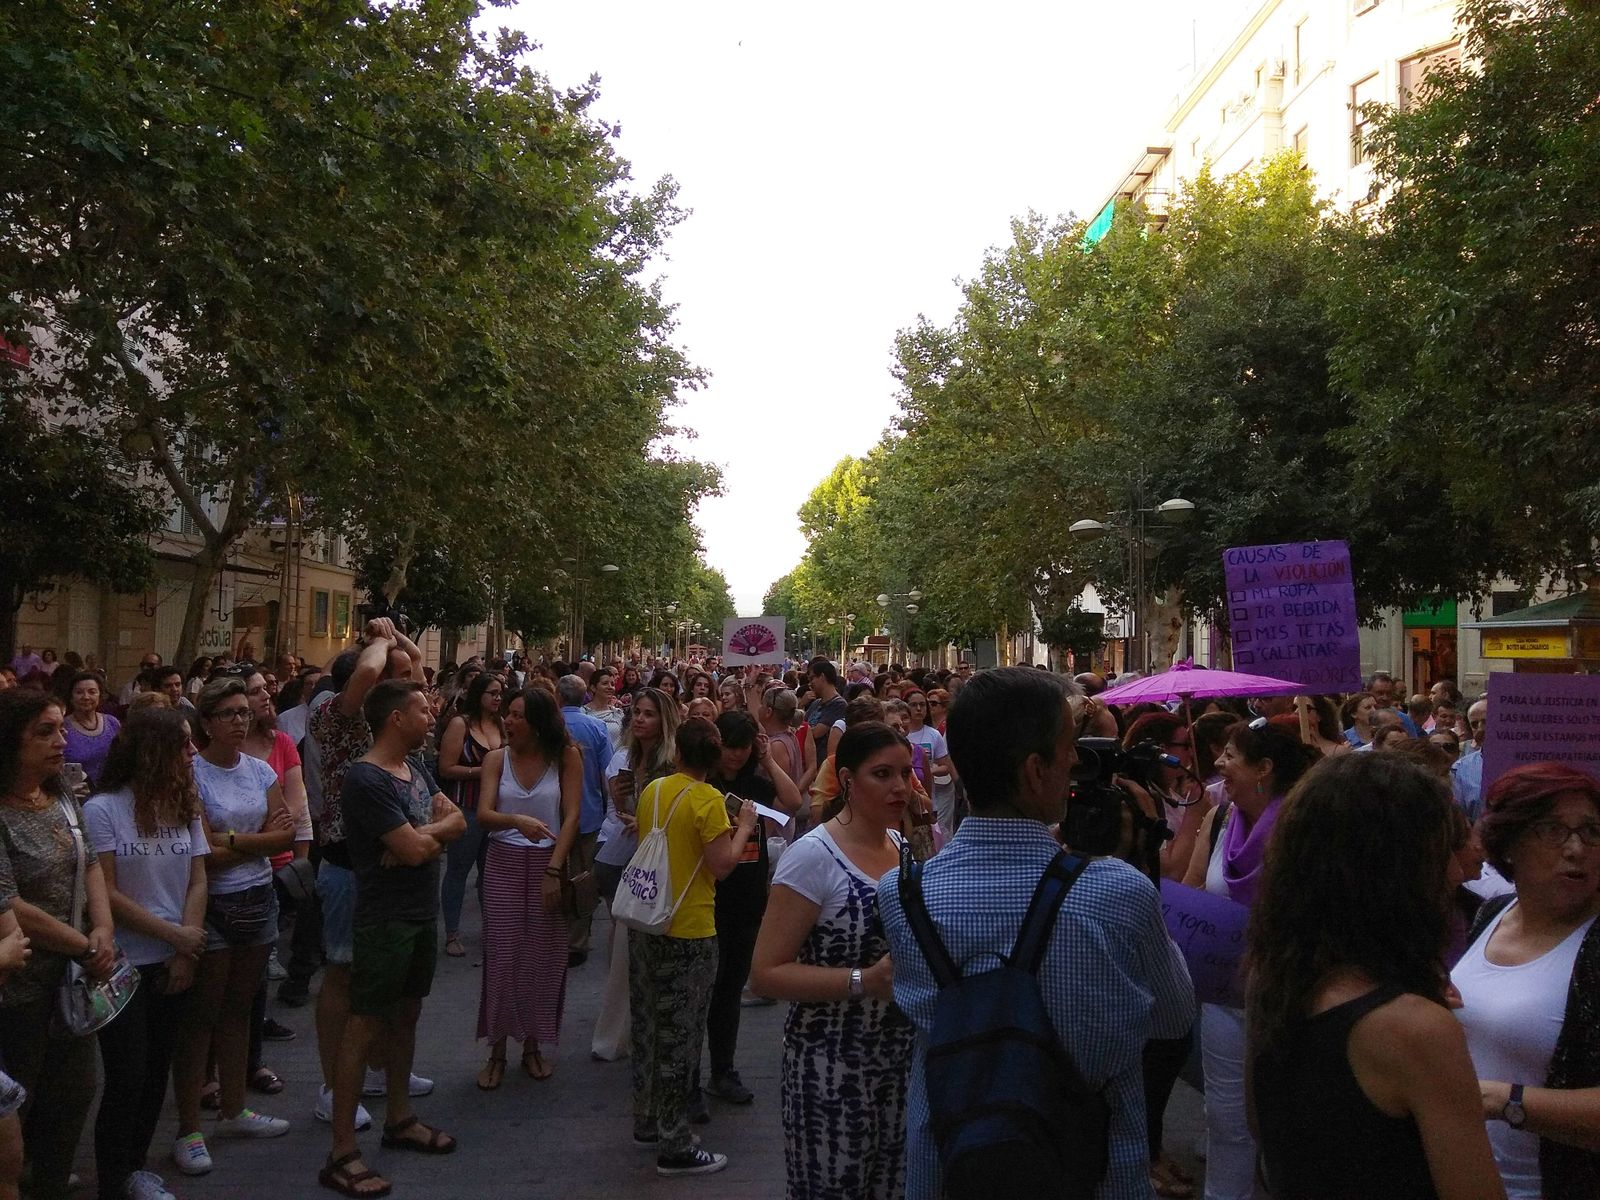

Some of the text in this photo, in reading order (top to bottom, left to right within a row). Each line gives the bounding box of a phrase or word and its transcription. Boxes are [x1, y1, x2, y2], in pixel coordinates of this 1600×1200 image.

[1228, 544, 1321, 565] CAUSAS DE
[1244, 558, 1345, 583] LA VIOLACIÓN
[1252, 583, 1319, 599] MI ROPA
[1255, 600, 1342, 619] IR BEBIDA
[1255, 621, 1345, 641] MIS TETAS
[1262, 667, 1360, 687] OLADORES
[1500, 695, 1527, 706] PARA
[1529, 696, 1541, 706] LA
[1544, 696, 1584, 707] JUSTICIA
[1500, 713, 1519, 723] LAS
[1520, 714, 1563, 725] MUJERES
[1496, 730, 1530, 741] VALOR
[1532, 732, 1541, 741] SI
[1544, 731, 1587, 742] ESTAMOS
[115, 842, 150, 857] LIKE
[154, 843, 165, 856] A
[1177, 911, 1217, 940] ropa
